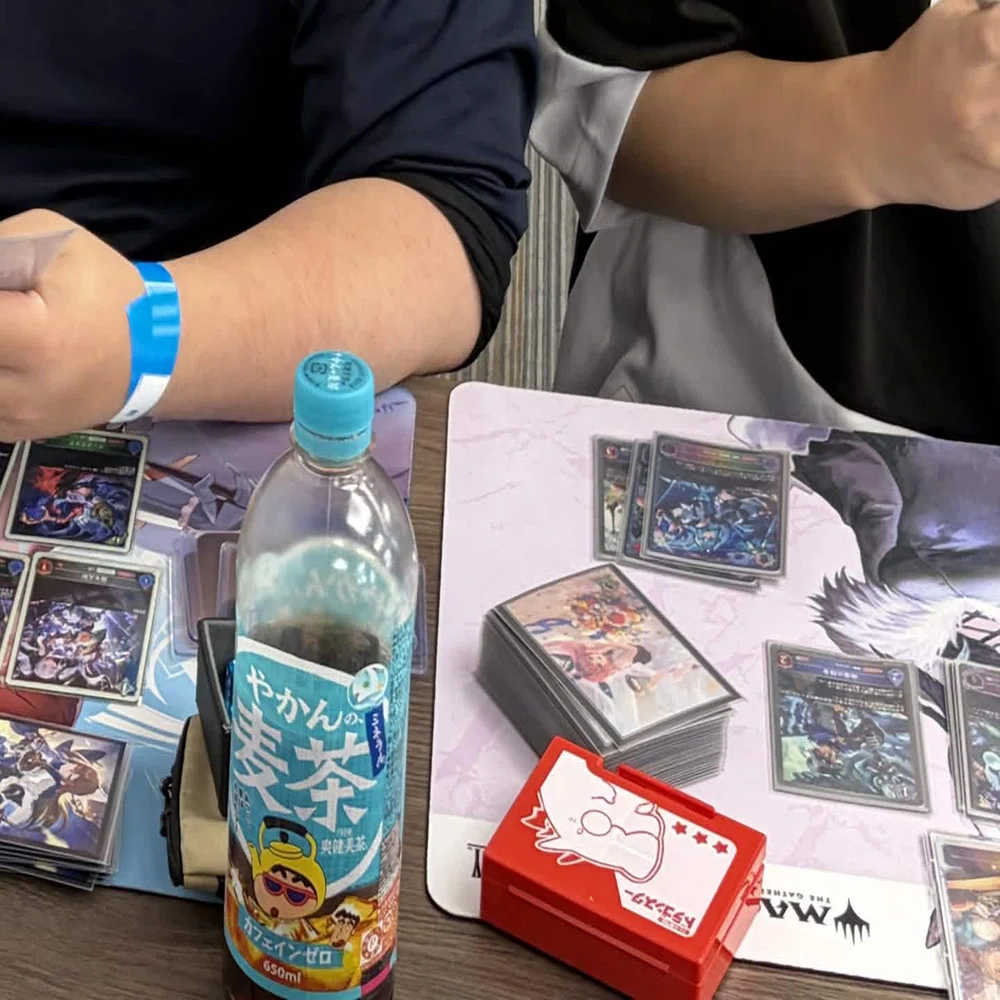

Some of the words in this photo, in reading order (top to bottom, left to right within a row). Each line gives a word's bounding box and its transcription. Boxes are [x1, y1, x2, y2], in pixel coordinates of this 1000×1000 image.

[233, 695, 378, 833] 麦茶
[809, 894, 831, 904] THE
[243, 915, 332, 965] カフェインゼロ
[262, 959, 302, 984] 650ml
